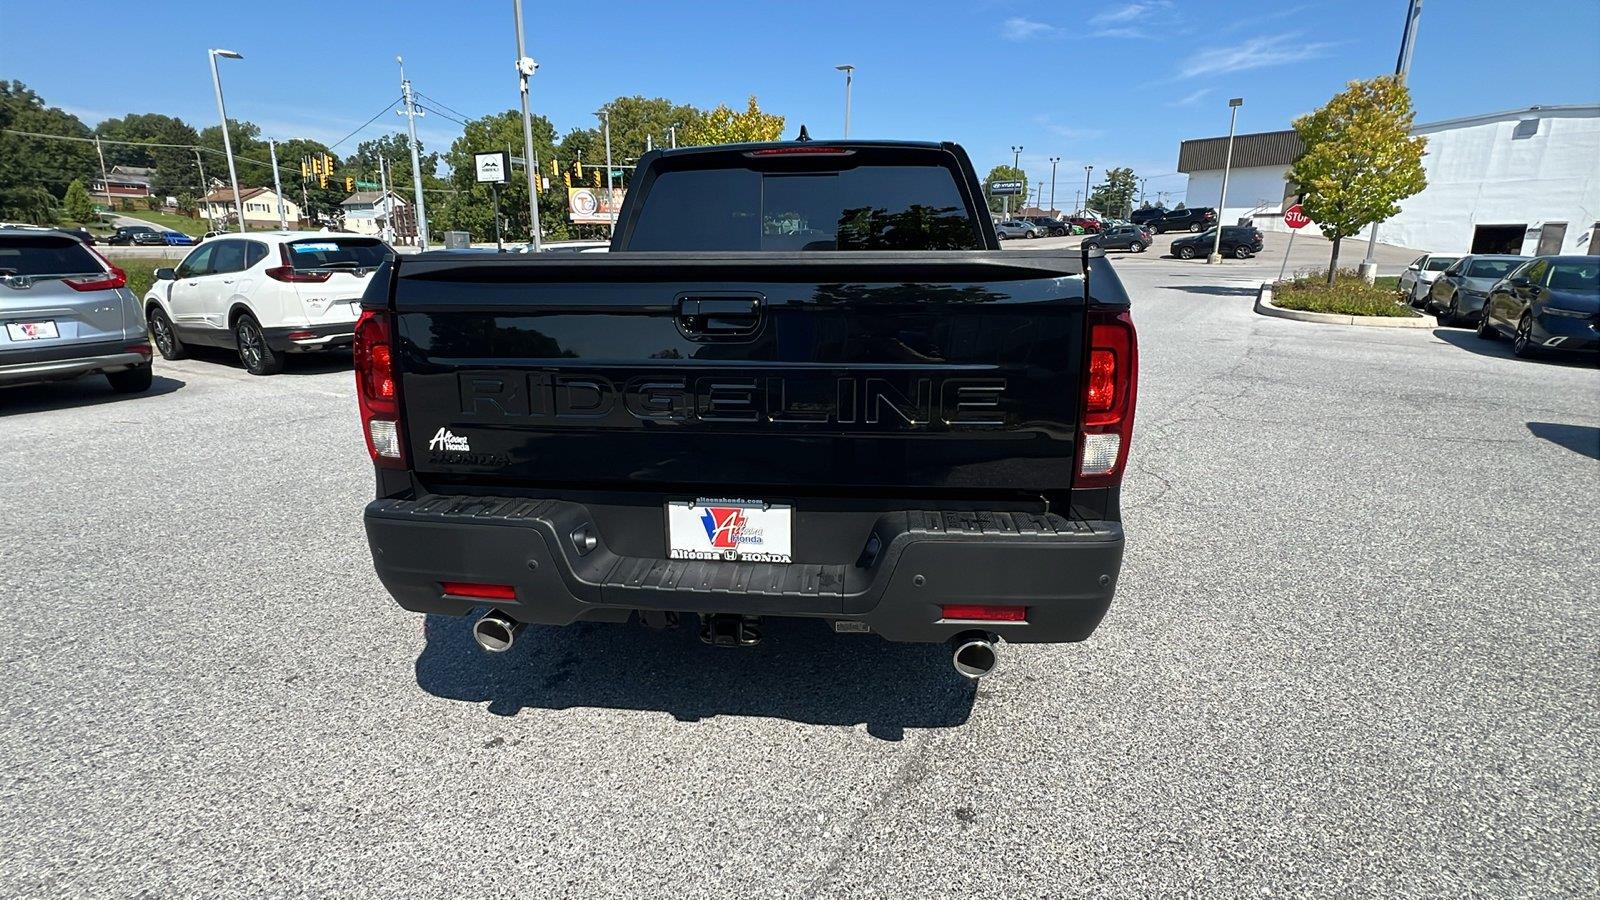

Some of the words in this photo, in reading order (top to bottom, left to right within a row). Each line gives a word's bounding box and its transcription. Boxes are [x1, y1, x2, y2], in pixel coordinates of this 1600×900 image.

[457, 373, 1009, 426] RIDGELINE
[445, 442, 470, 452] Honda
[731, 533, 763, 544] Honda
[670, 548, 720, 561] Altoona
[742, 552, 791, 563] HONDA
